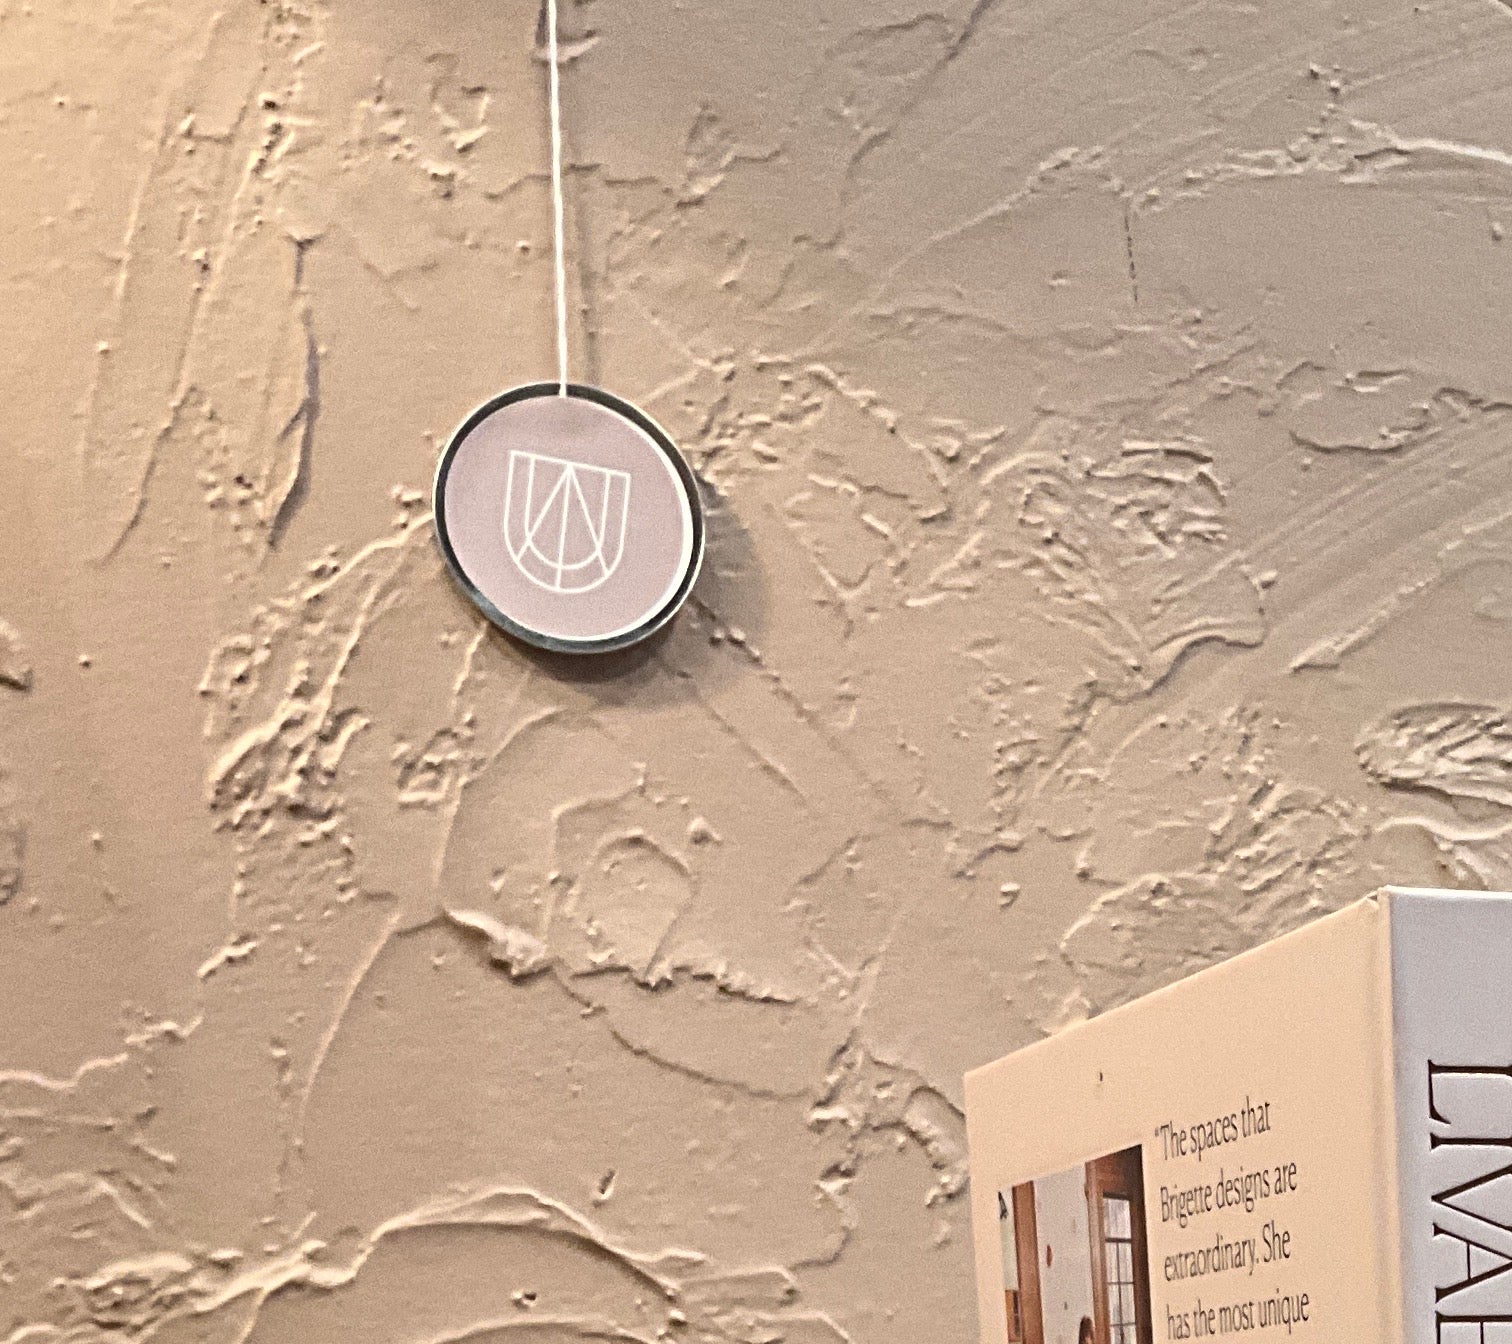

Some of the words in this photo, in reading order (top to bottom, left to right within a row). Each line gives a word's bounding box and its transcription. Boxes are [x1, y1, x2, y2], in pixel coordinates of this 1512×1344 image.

[1190, 1110, 1239, 1162] spaces
[1241, 1095, 1272, 1136] that
[1160, 1180, 1213, 1228] Brigette
[1216, 1166, 1271, 1213] designs
[1274, 1161, 1298, 1193] are
[1164, 1233, 1260, 1282] extraordinary.
[1262, 1219, 1292, 1265] She
[1166, 1302, 1191, 1341] has
[1193, 1298, 1216, 1336] the
[1219, 1299, 1255, 1334] most
[1257, 1288, 1310, 1336] unique
